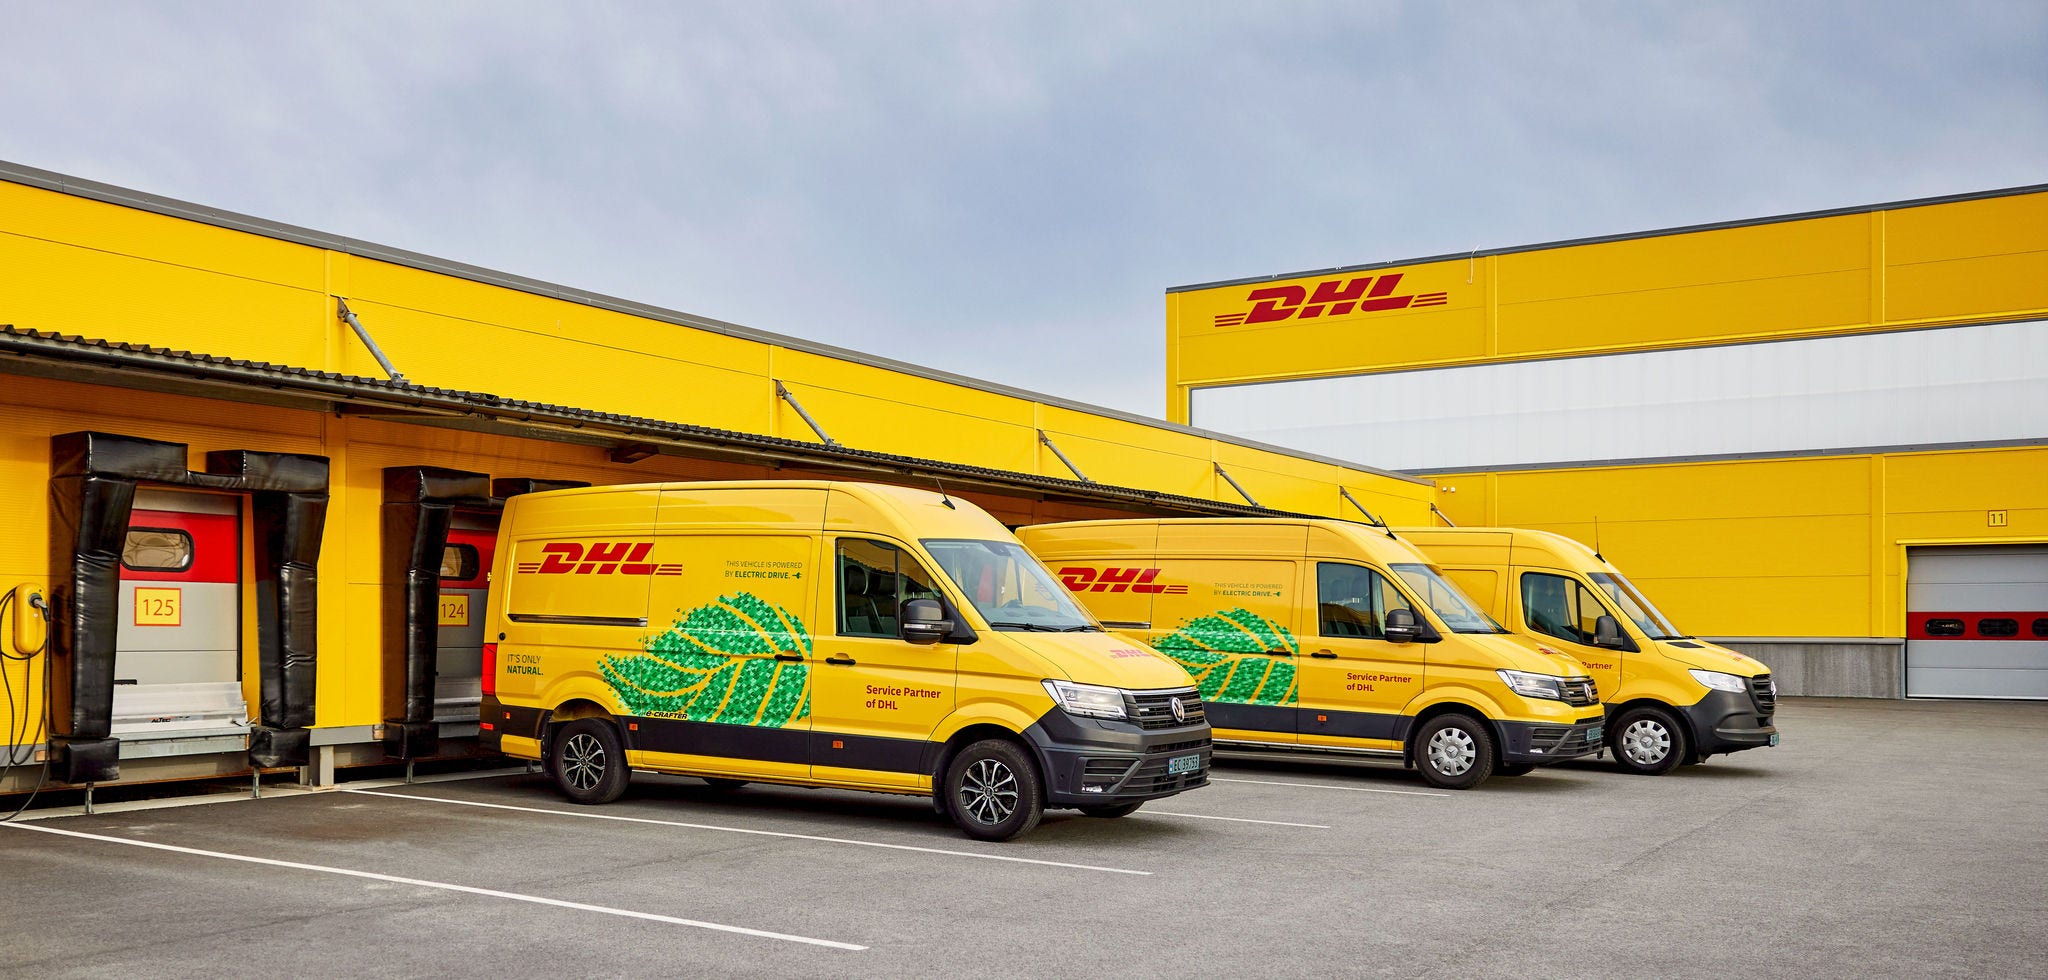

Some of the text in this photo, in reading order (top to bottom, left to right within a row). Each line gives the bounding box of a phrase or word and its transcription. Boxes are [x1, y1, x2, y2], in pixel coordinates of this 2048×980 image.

[1244, 273, 1415, 324] DHL
[1991, 514, 2003, 524] 11
[538, 543, 659, 575] DHL
[1058, 567, 1166, 594] DHL
[143, 599, 174, 616] 125
[442, 604, 464, 618] 124
[508, 654, 541, 664] IT'S ONLY
[507, 665, 544, 676] NATURAL.
[1347, 673, 1412, 683] Service Partner
[866, 685, 942, 698] Service Partner
[866, 699, 898, 710] of DHL
